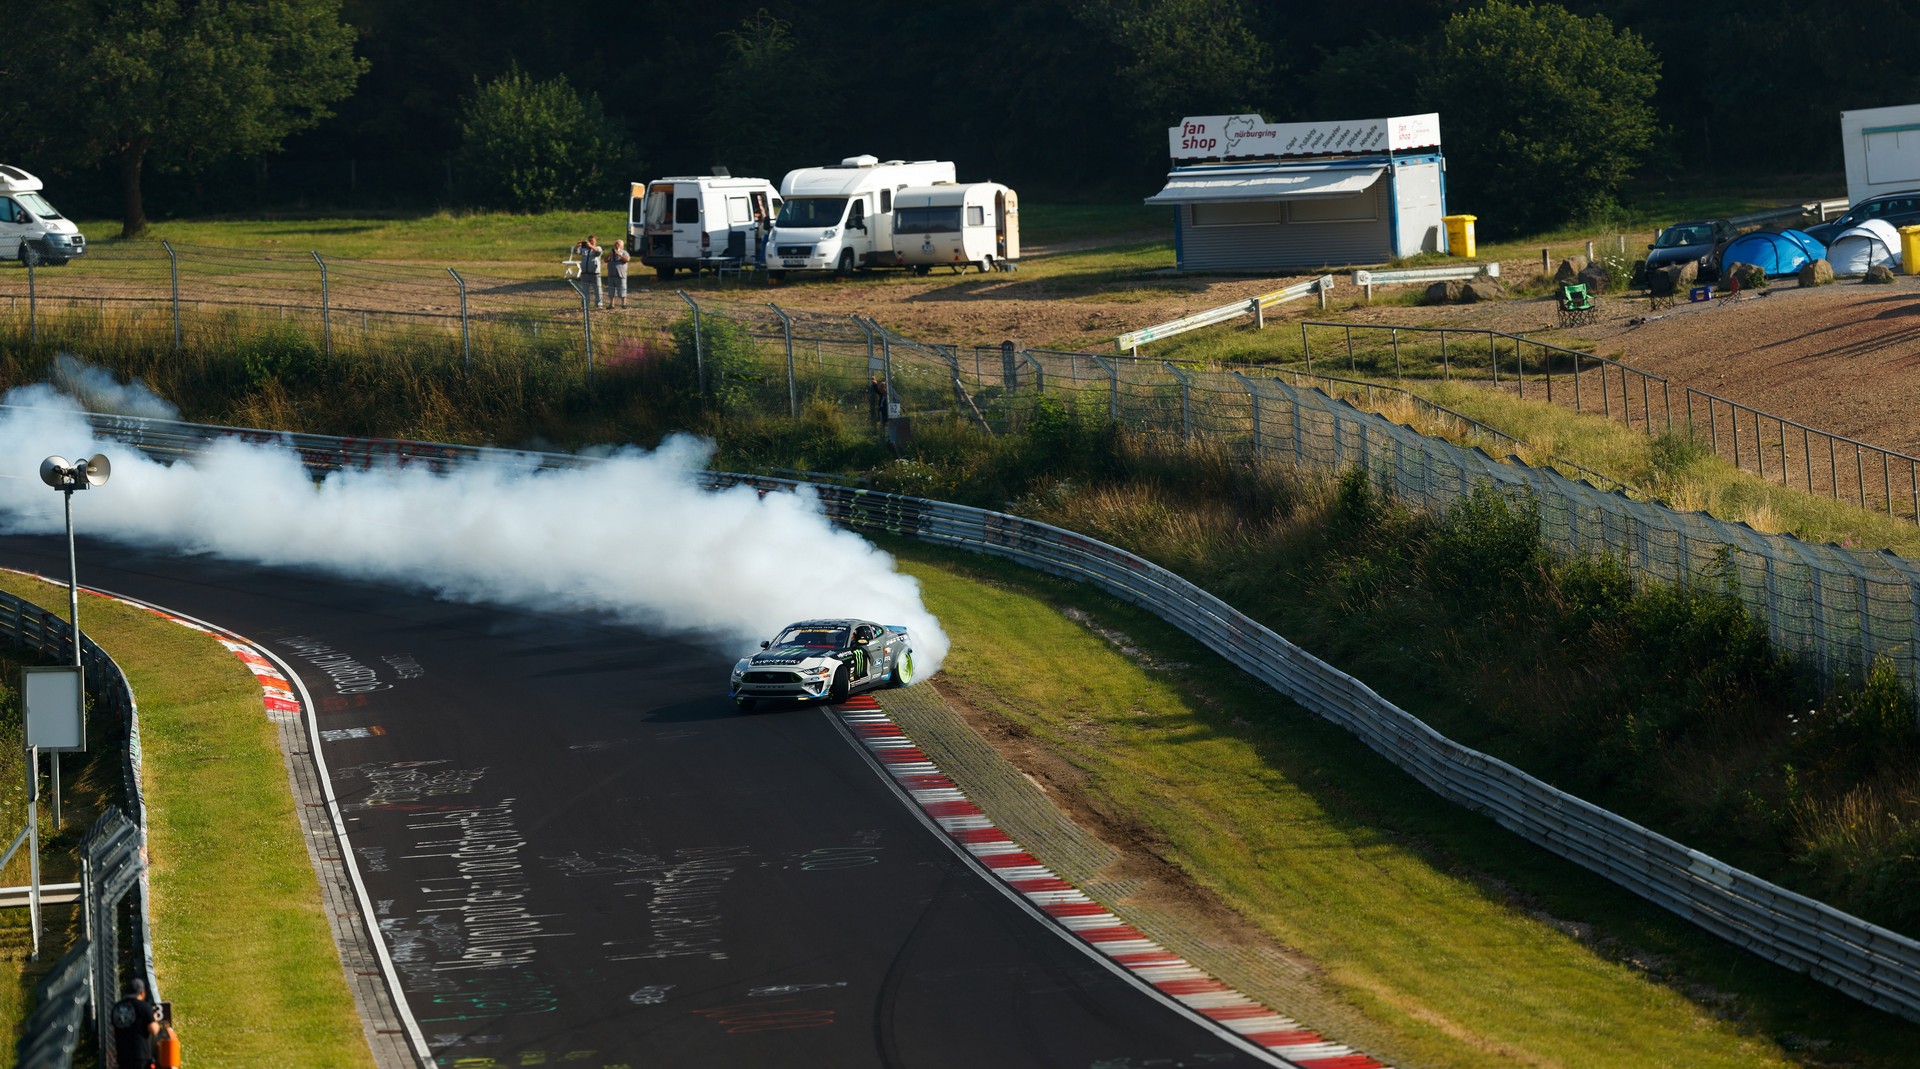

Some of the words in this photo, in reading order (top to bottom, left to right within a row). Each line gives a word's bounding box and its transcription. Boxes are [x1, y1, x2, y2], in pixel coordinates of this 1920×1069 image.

[1182, 121, 1205, 138] fan
[1234, 129, 1277, 138] nürburgring
[1182, 136, 1217, 151] shop
